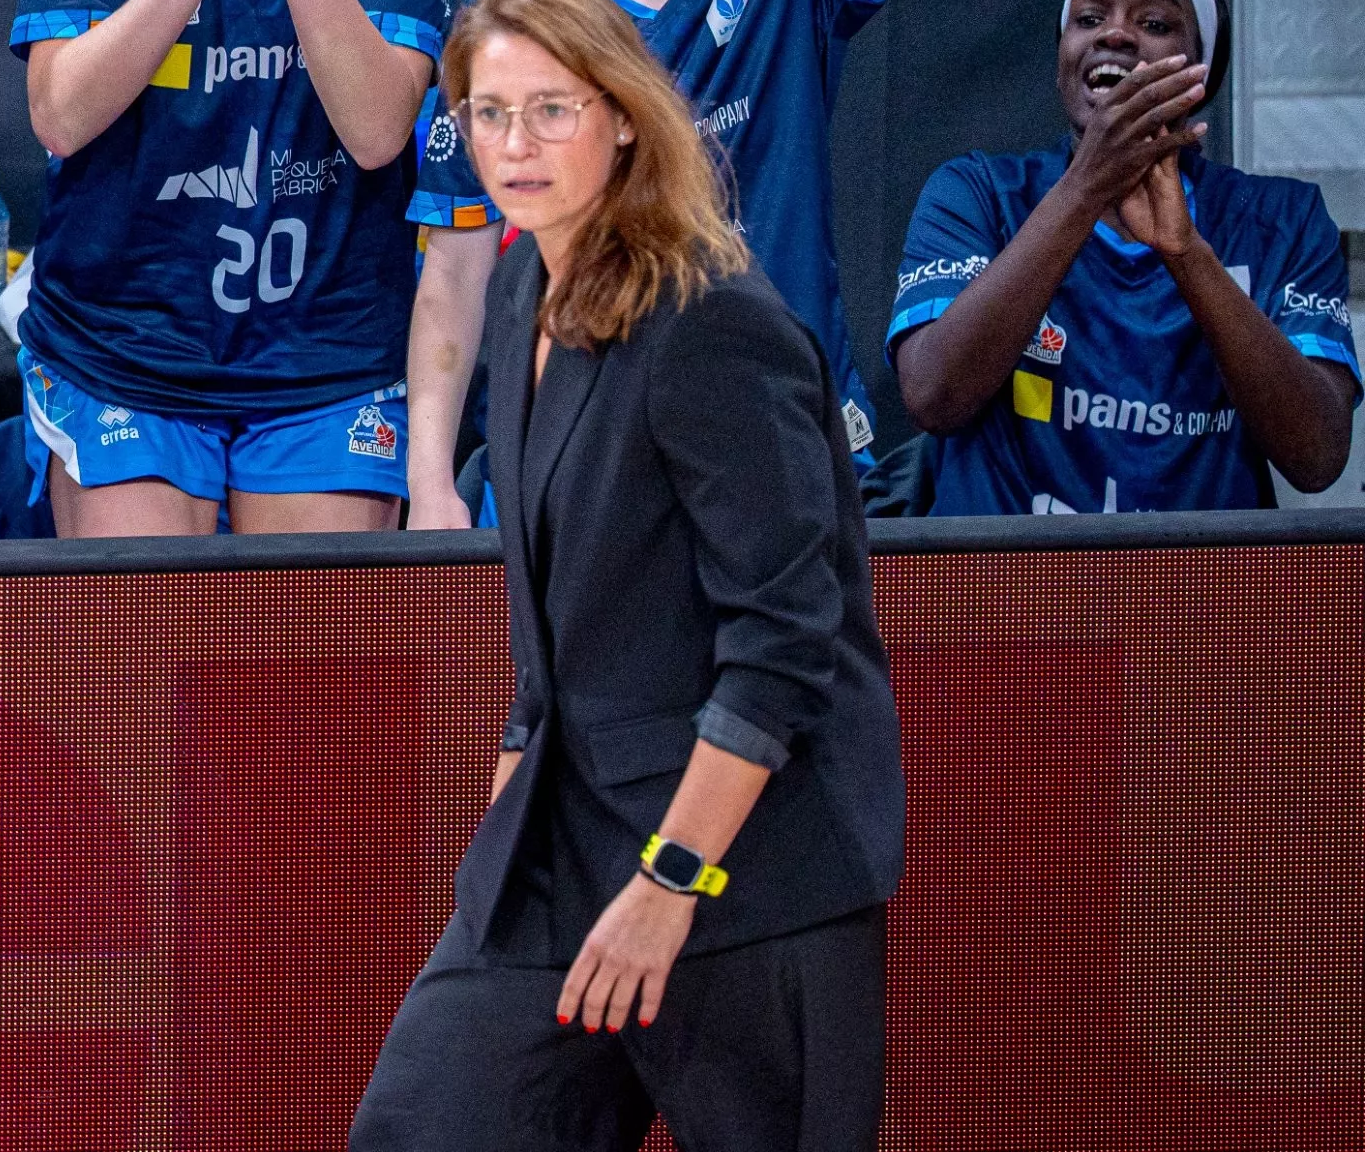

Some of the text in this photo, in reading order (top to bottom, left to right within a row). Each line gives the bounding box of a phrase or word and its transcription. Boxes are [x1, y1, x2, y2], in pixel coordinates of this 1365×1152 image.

[271, 148, 292, 167] MI
[212, 218, 307, 314] 20
[1026, 343, 1060, 361] VENIDA
[1064, 386, 1171, 436] pans
[1173, 412, 1183, 435] &
[100, 427, 140, 446] errea
